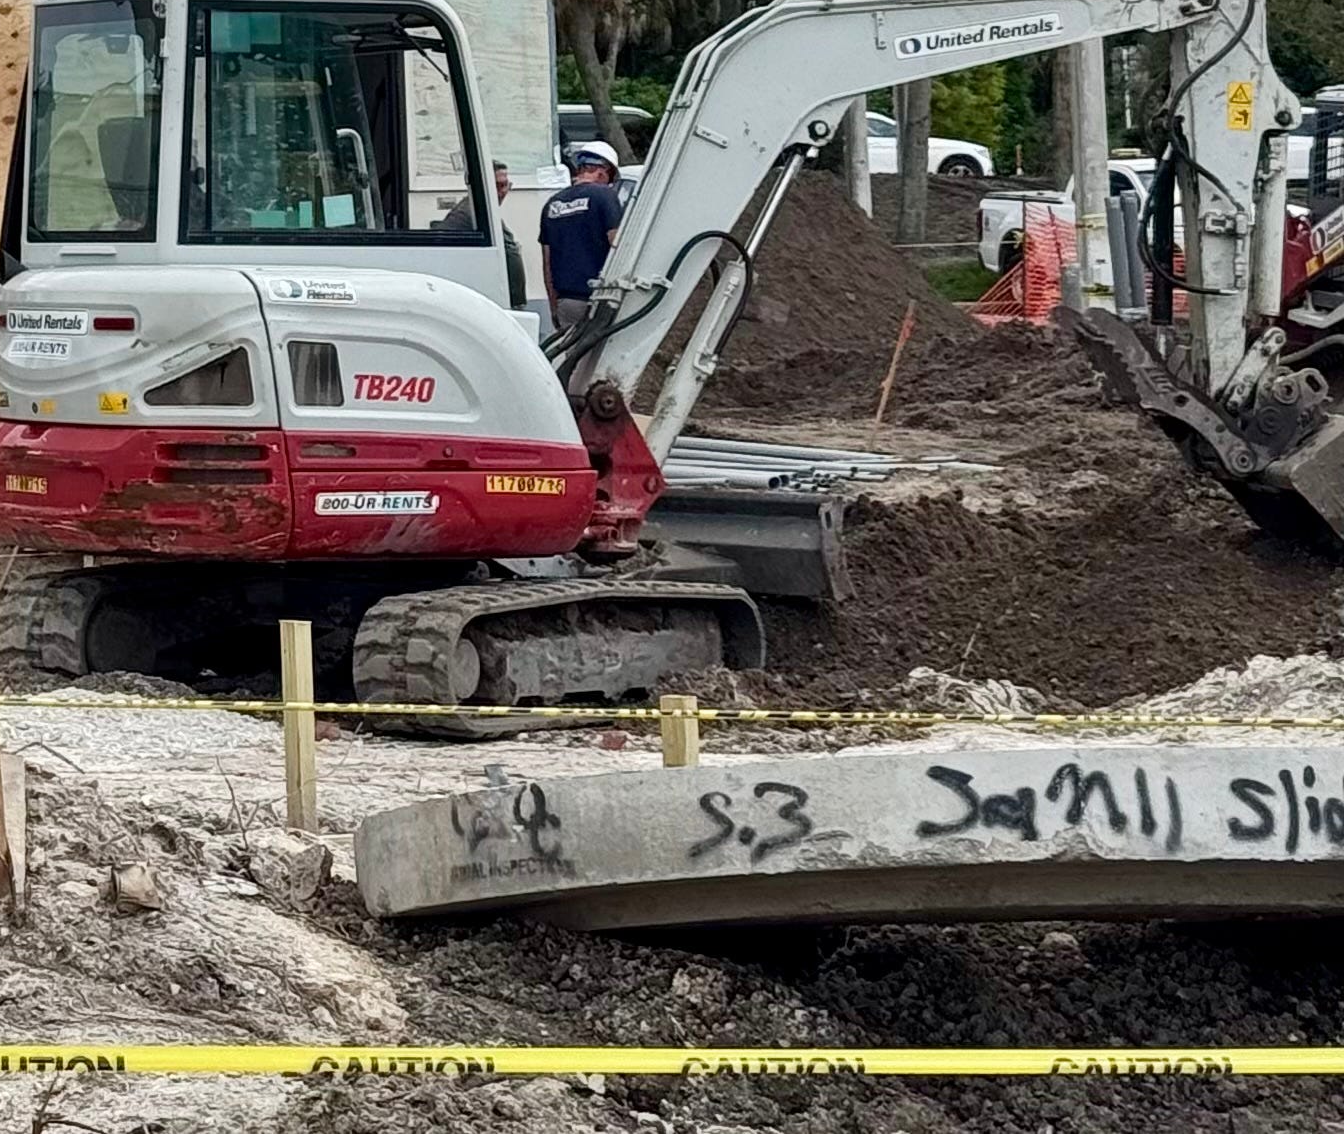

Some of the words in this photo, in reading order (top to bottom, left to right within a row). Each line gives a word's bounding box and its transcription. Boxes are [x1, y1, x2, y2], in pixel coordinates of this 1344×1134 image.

[926, 28, 985, 50] United
[989, 18, 1054, 41] Rentals
[18, 313, 42, 329] United
[44, 314, 83, 330] Rentals
[354, 374, 436, 403] TB240
